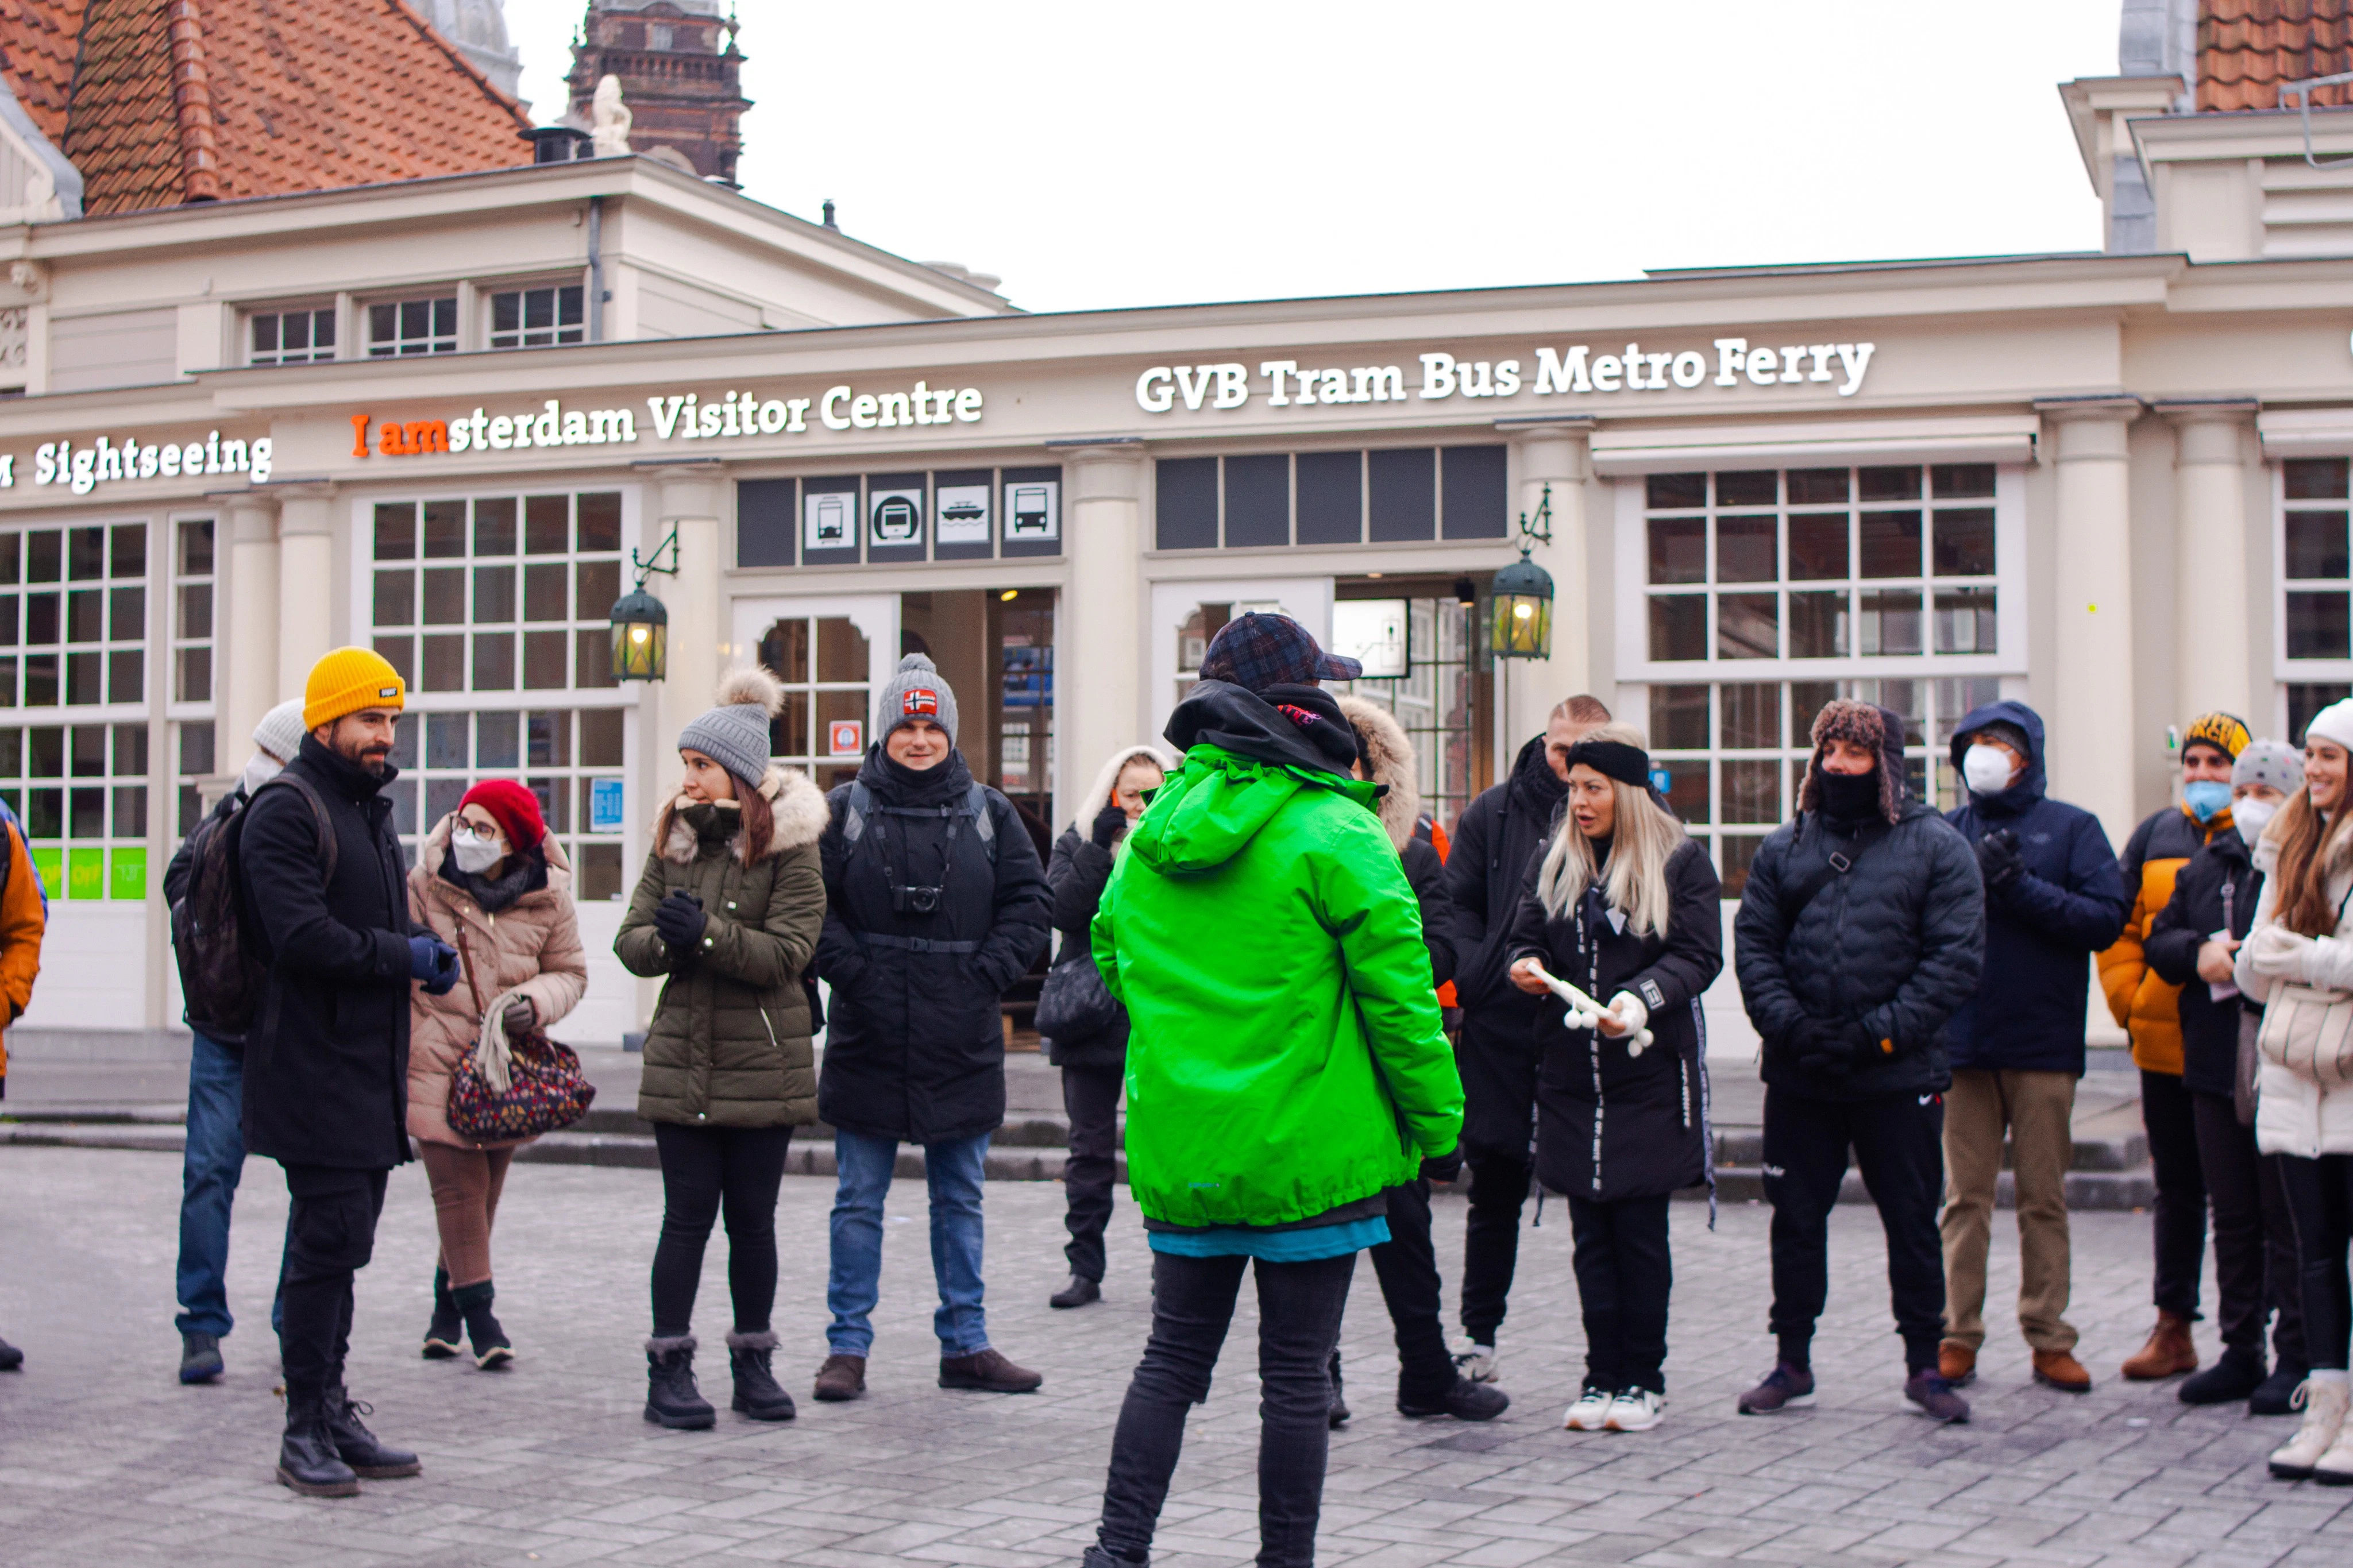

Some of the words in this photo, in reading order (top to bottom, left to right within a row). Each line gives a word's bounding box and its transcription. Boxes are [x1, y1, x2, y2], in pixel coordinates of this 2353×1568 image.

[1136, 364, 1247, 411] GVB
[1261, 361, 1407, 405] Tram
[1419, 353, 1520, 398] Bus
[1533, 344, 1705, 393] Metro
[1715, 339, 1874, 395] Ferry
[350, 414, 369, 458] I
[379, 400, 637, 455] amsterdam
[648, 391, 809, 438] Visitor
[821, 382, 982, 429] Centre
[35, 431, 272, 495] Sightseeing
